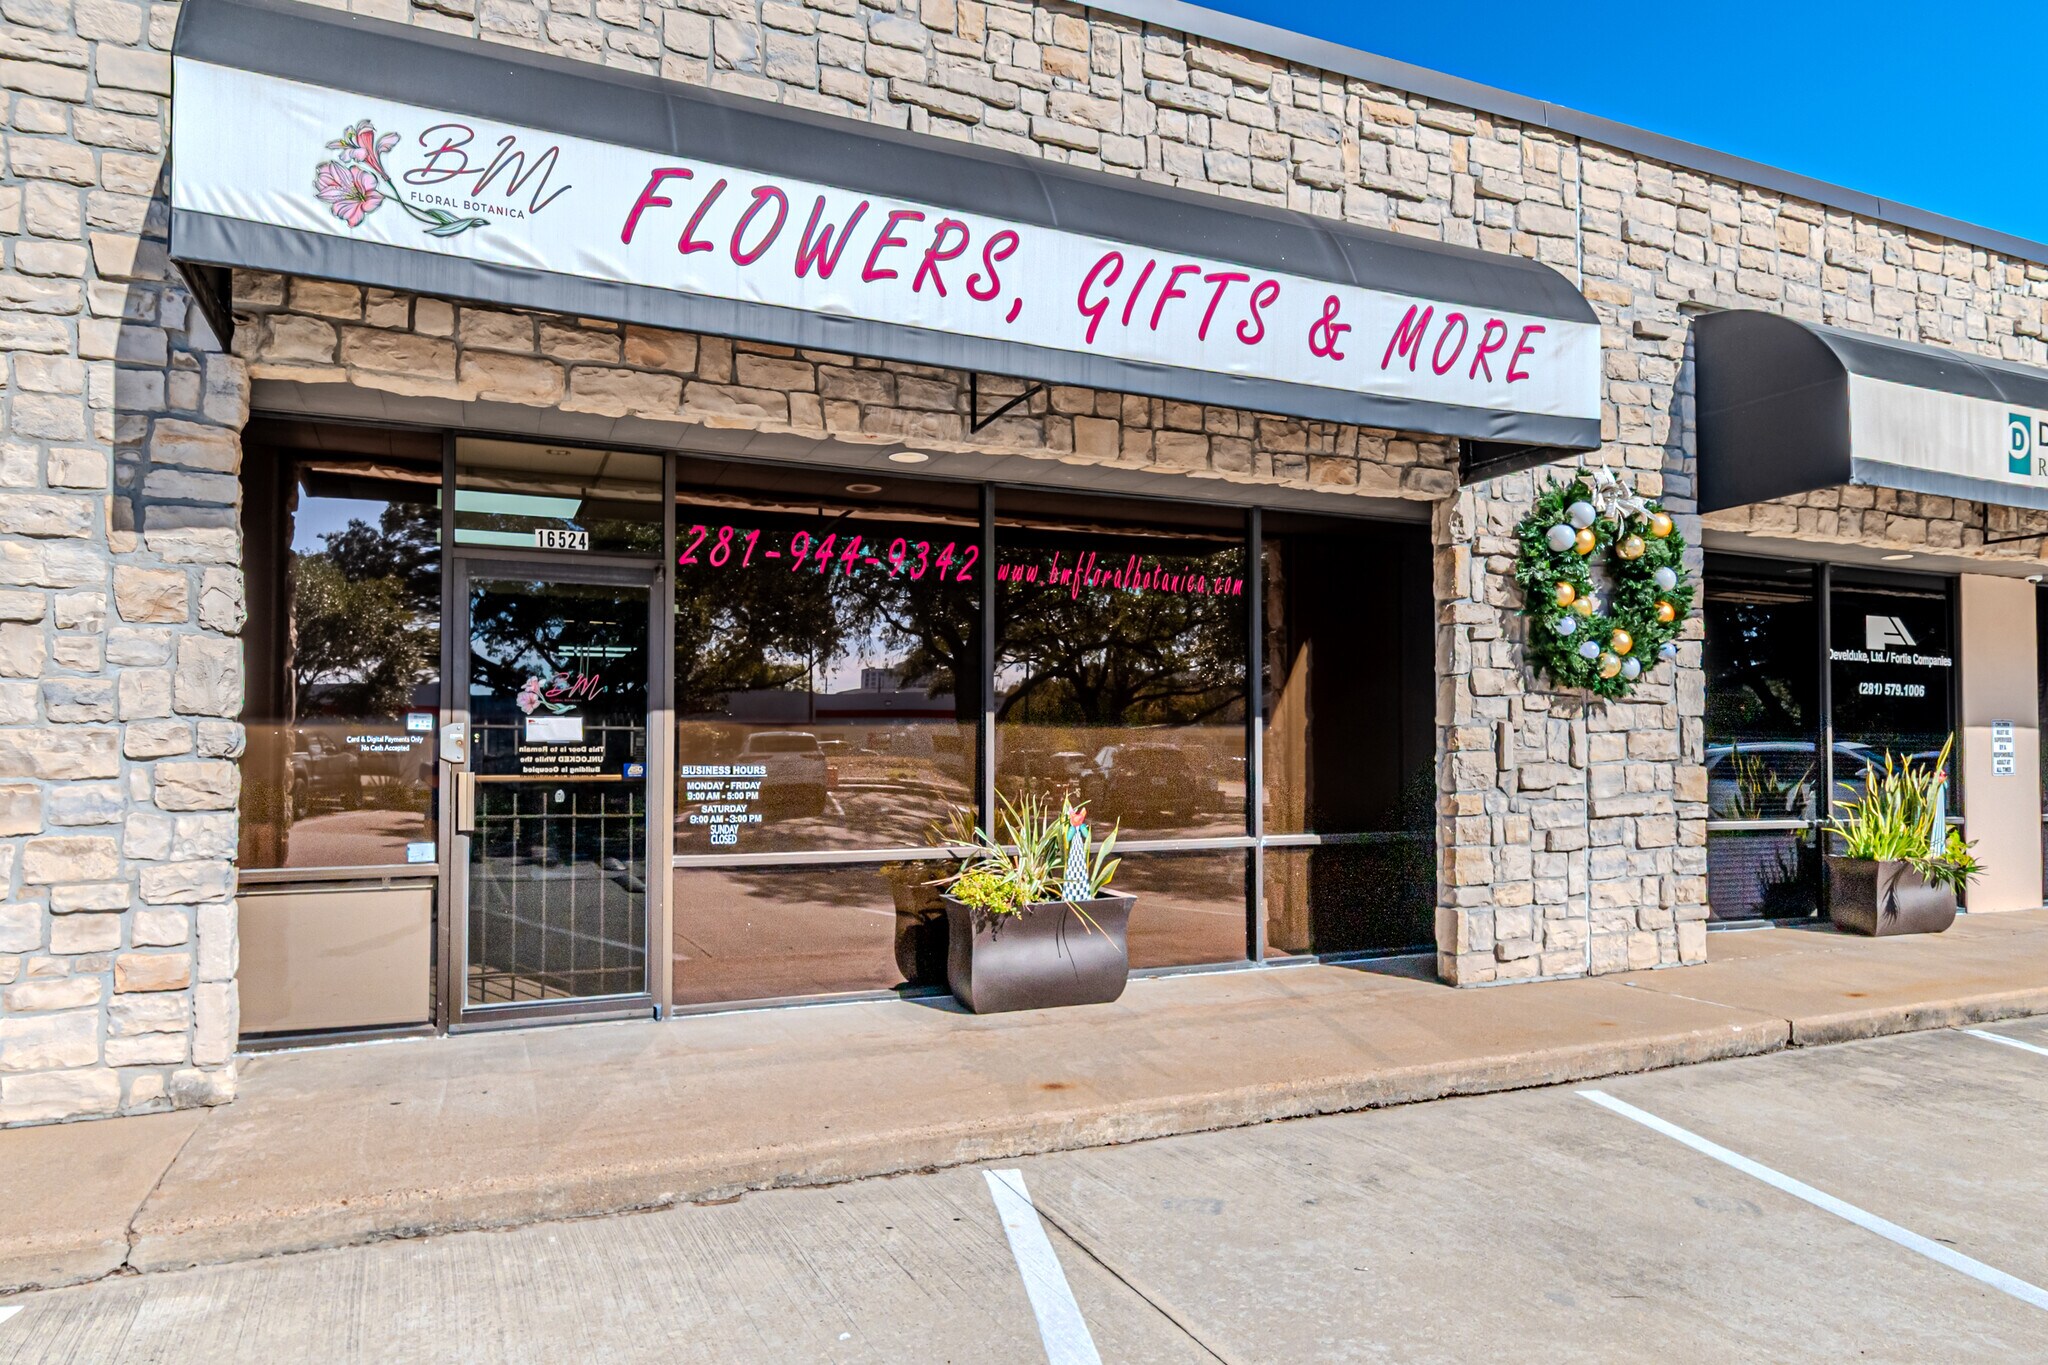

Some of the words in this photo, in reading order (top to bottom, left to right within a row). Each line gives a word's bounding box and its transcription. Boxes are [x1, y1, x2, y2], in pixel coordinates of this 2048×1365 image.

[403, 123, 572, 214] BM
[410, 191, 458, 208] FLORAL
[463, 200, 525, 220] BOTANICA
[621, 167, 1023, 324] FLOWERS,
[1077, 251, 1280, 345] GIFTS
[1308, 295, 1351, 361] &
[1381, 304, 1546, 383] MORE
[538, 530, 586, 549] 16524
[679, 525, 979, 582] 281-944-9342
[1870, 651, 1885, 663] Ltd.
[1890, 652, 1911, 664] Fortis
[1913, 654, 1952, 668] Companies
[1858, 682, 1882, 695] (281)
[1884, 683, 1925, 697] 579.1006
[346, 735, 360, 743] Card
[366, 735, 384, 744] Digital
[384, 735, 410, 744] Payments
[410, 735, 424, 744] Only
[682, 765, 731, 775] BUSINESS
[732, 765, 767, 775] HOURS
[686, 781, 724, 790] MONDAY
[730, 781, 761, 790] FRIDAY
[687, 792, 705, 800] 9:00
[706, 792, 720, 800] AM
[727, 792, 744, 800] 5:00
[745, 791, 759, 799] PM
[701, 804, 747, 813] SATURDAY
[689, 815, 708, 824] 9:00
[709, 815, 724, 823] AM
[729, 814, 747, 823] 3:00
[748, 814, 762, 822] PM
[710, 824, 739, 834] SUNDAY
[710, 834, 738, 844] CLOSED
